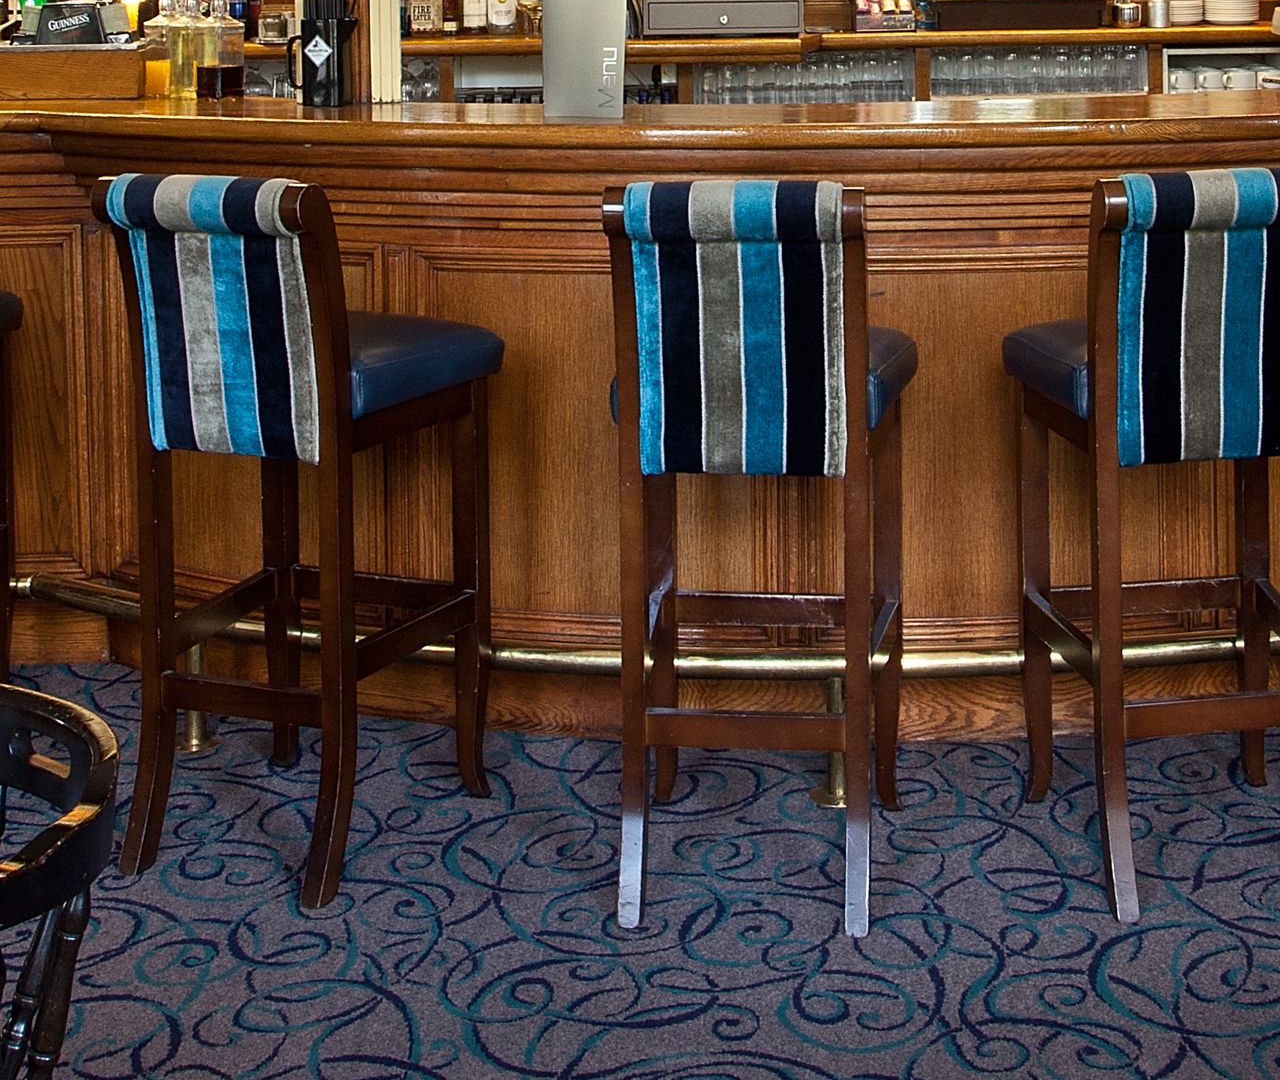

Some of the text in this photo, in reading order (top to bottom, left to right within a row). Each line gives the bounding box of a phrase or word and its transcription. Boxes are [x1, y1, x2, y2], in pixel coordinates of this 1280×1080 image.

[412, 5, 431, 15] FIRE
[48, 13, 91, 31] GUINNESS
[413, 14, 431, 22] EATER
[598, 47, 618, 109] Menu
